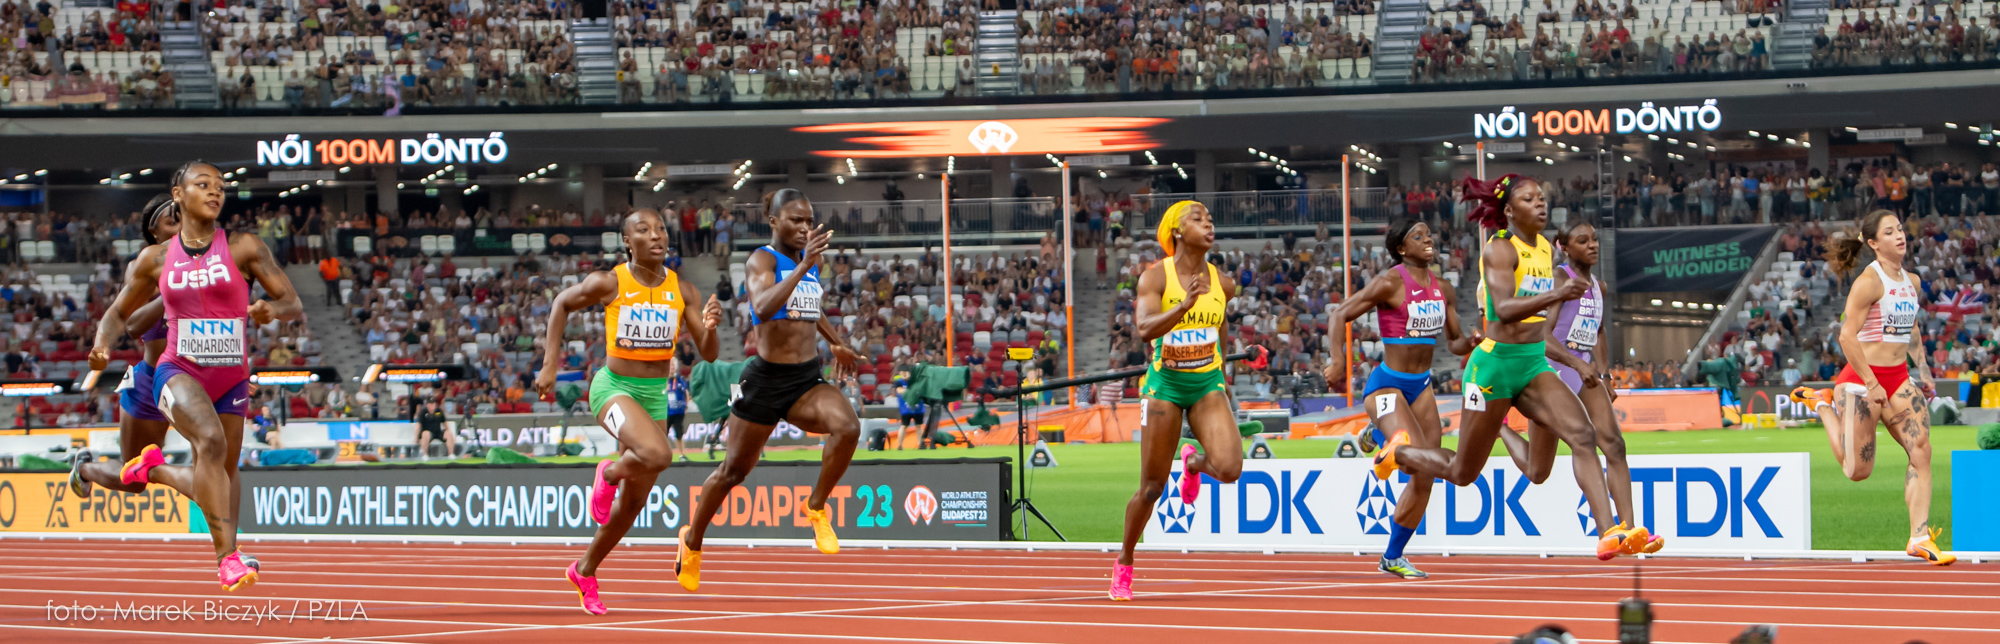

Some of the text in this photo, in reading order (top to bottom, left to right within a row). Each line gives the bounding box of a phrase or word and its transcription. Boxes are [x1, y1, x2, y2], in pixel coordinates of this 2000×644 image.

[1474, 99, 1722, 138] NŐI 100M DÖNTŐ
[256, 131, 509, 165] NŐI 100M DÖNTŐ
[1653, 241, 1741, 264] WITNESS
[1643, 256, 1753, 279] THE WONDER
[167, 263, 231, 290] USA
[1532, 278, 1553, 290] NTN
[796, 282, 818, 295] NTN
[790, 296, 820, 310] ALFRE
[1417, 302, 1441, 315] NTN
[1894, 302, 1914, 312] NTN
[630, 308, 668, 323] NTN
[1412, 315, 1444, 329] BROWN
[191, 320, 234, 335] NTN
[624, 324, 671, 339] TA LOU
[1171, 328, 1207, 345] NTN
[180, 338, 241, 354] RICHARDSON
[1381, 397, 1388, 412] 3
[1470, 393, 1478, 406] 4
[608, 411, 617, 429] 7
[941, 491, 987, 499] WORLD ATHLETICS
[1200, 470, 1325, 534] TDK
[1630, 466, 1784, 539] TDK
[80, 488, 183, 523] PROSPEX
[253, 486, 333, 526] WORLD
[336, 485, 462, 527] ATHLETICS
[855, 484, 894, 528] 23
[941, 500, 987, 509] CHAMPIONSHIPS
[941, 510, 988, 520] BUDAPEST 23
